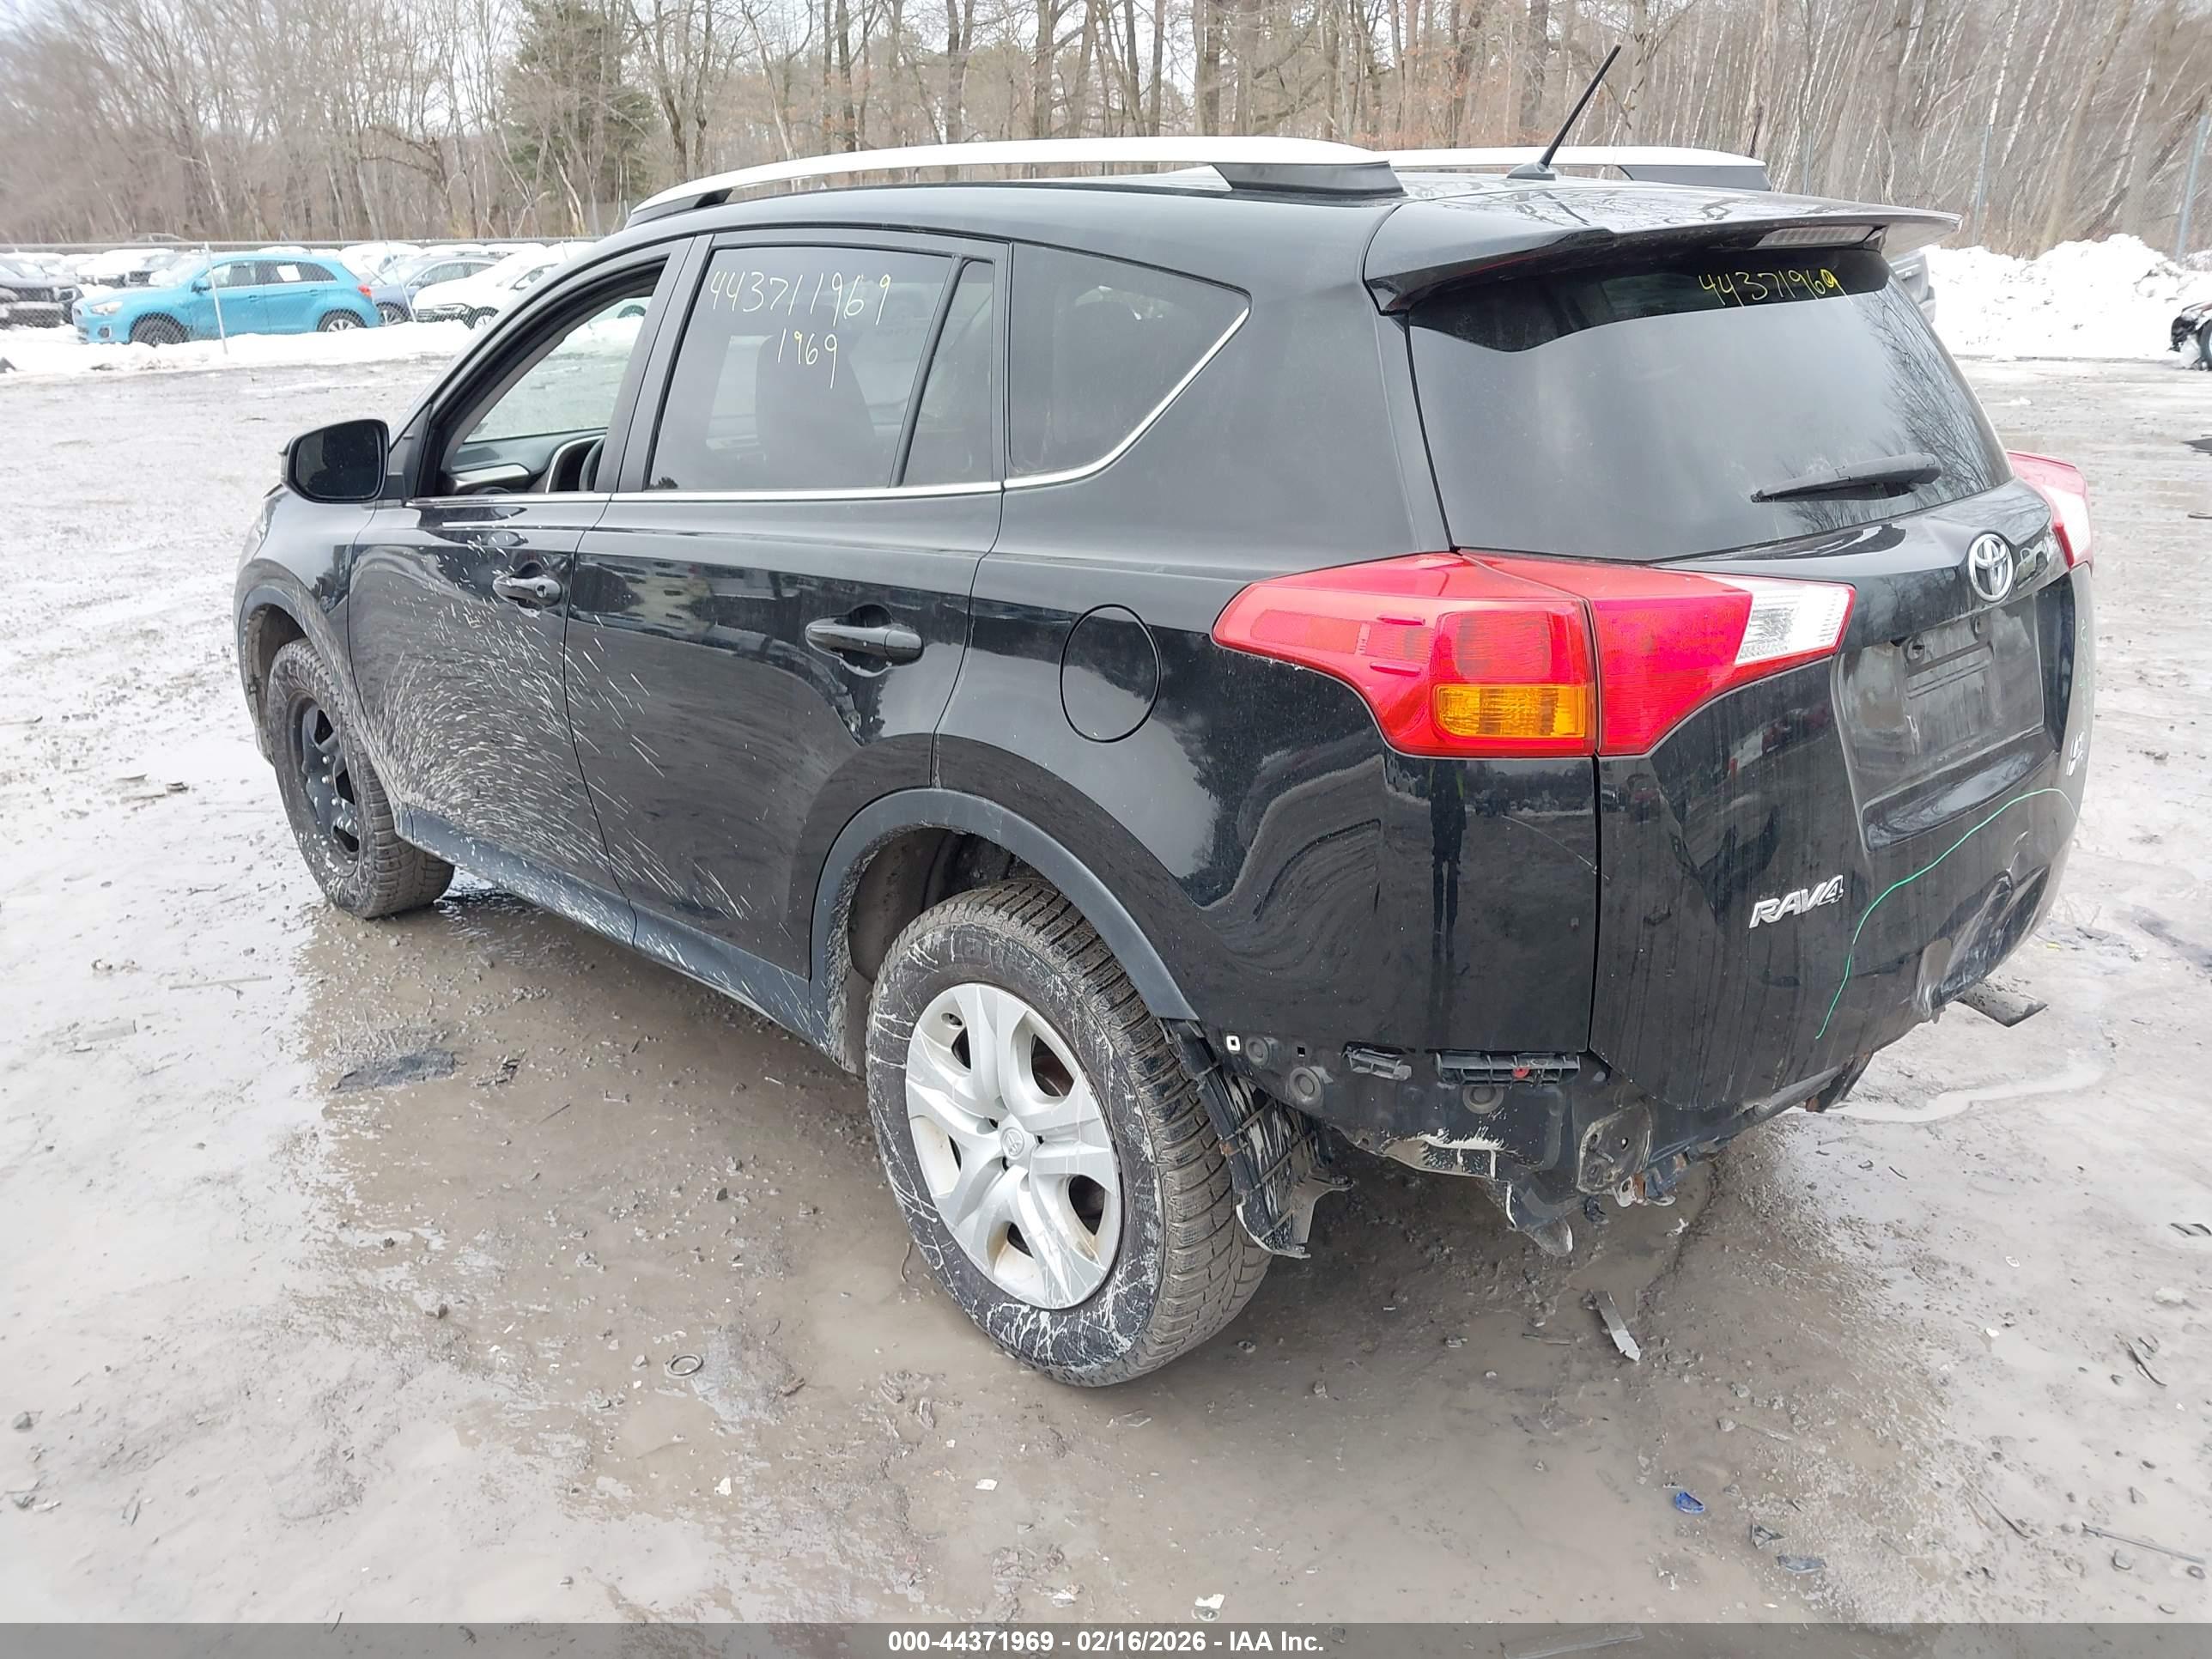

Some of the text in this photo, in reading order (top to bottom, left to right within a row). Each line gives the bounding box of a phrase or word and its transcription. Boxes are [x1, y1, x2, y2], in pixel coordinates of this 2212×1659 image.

[710, 271, 891, 327] 443711969
[1698, 268, 1854, 308] 44371969
[777, 327, 838, 389] 1969
[1748, 874, 1844, 929] RAV4
